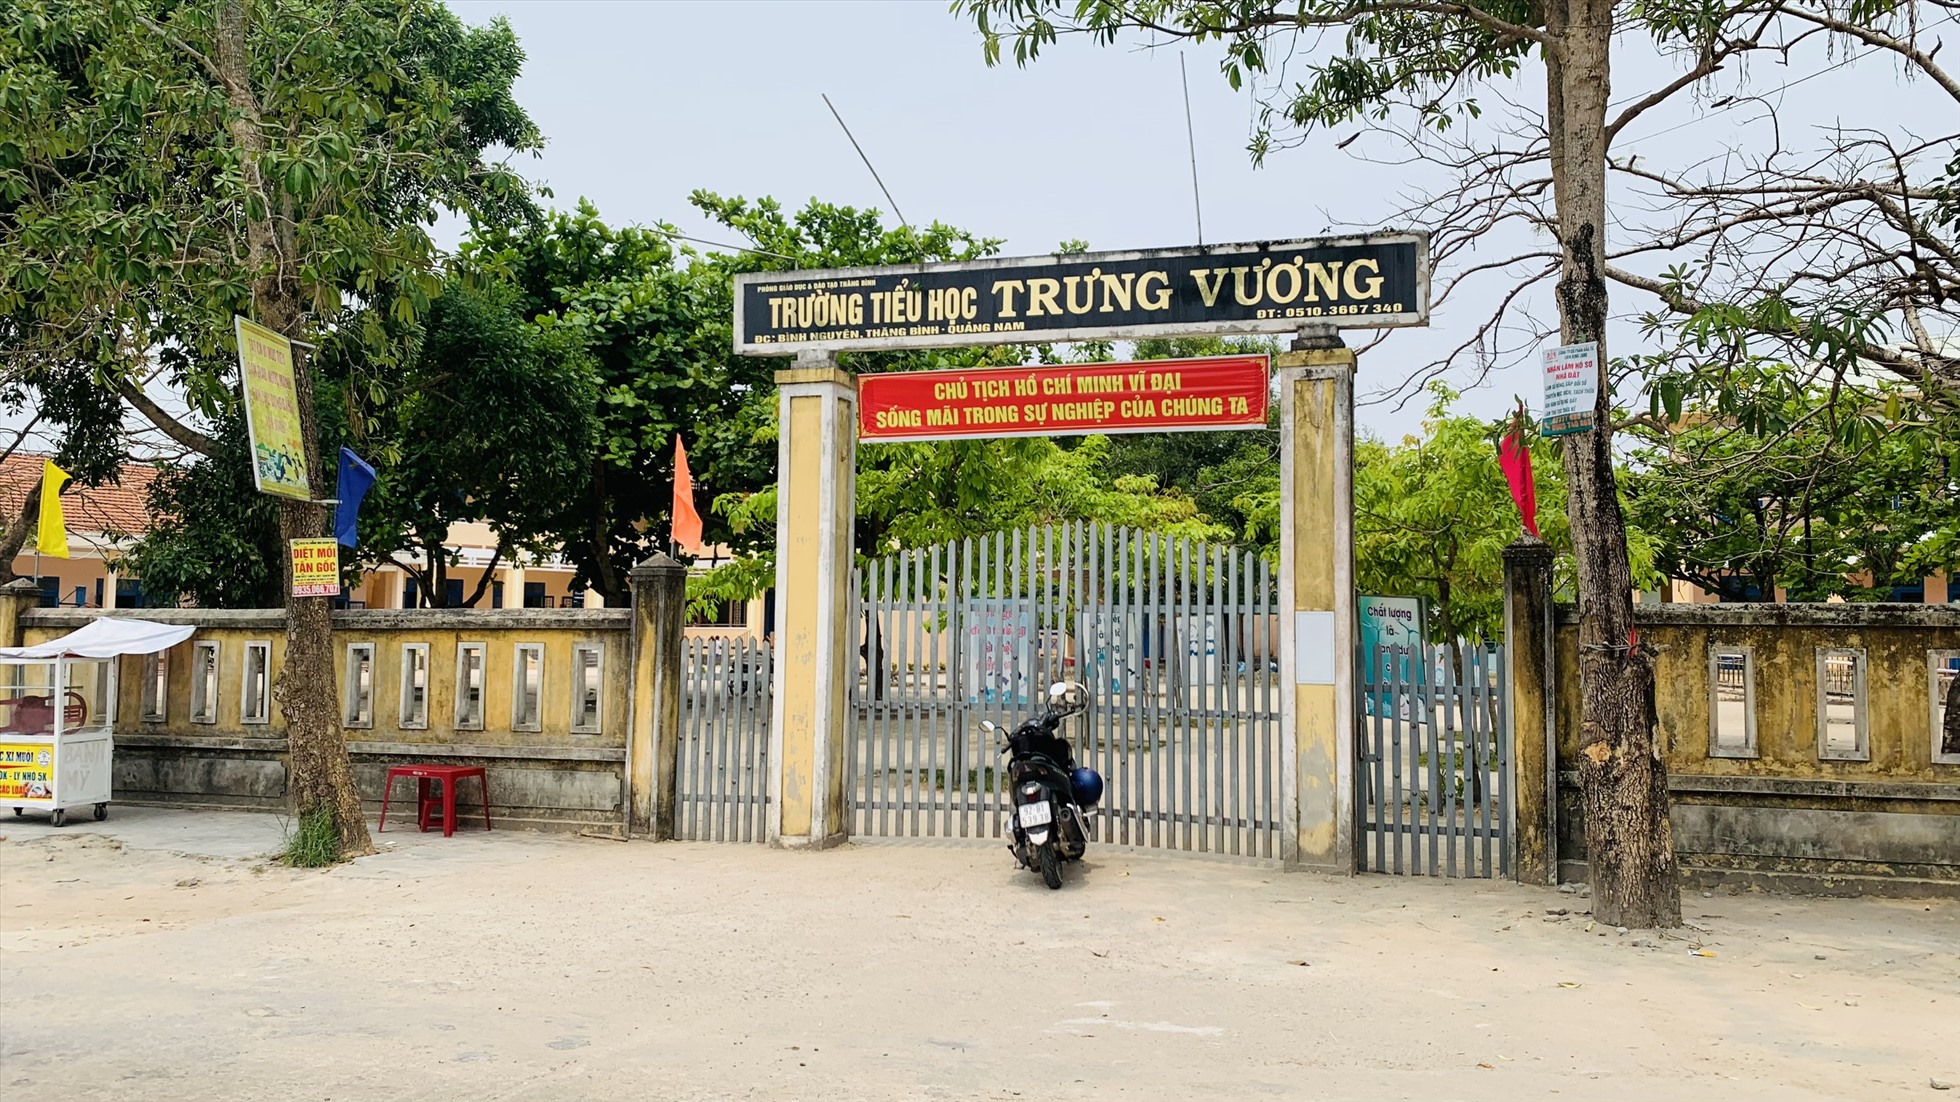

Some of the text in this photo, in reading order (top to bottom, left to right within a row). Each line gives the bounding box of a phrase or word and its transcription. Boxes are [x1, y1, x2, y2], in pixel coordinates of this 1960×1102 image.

[769, 255, 1385, 328] TRƯỜNG TIỂU HỌC TRƯNG VƯƠNG
[1256, 303, 1403, 319] ĐT: 0510.3667 340
[754, 335, 776, 343] ĐC:
[778, 332, 807, 342] BÌNH
[865, 327, 906, 338] THĂNG
[909, 324, 939, 335] BÌNH
[948, 321, 991, 334] QUẢNG
[994, 321, 1025, 332] NAM
[934, 370, 1182, 402] CHỦ TỊCH HỒ CHÍ MINH VĨ ĐẠI
[875, 394, 1249, 428] SỐNG MÃI TRONG SỰ NGHIỆP CỦA CHÚNG TA
[293, 544, 336, 561] DIỆT MỐI
[294, 558, 336, 575] TẬN GỐC
[1366, 602, 1412, 621] Chất lượng
[1386, 624, 1395, 636] là
